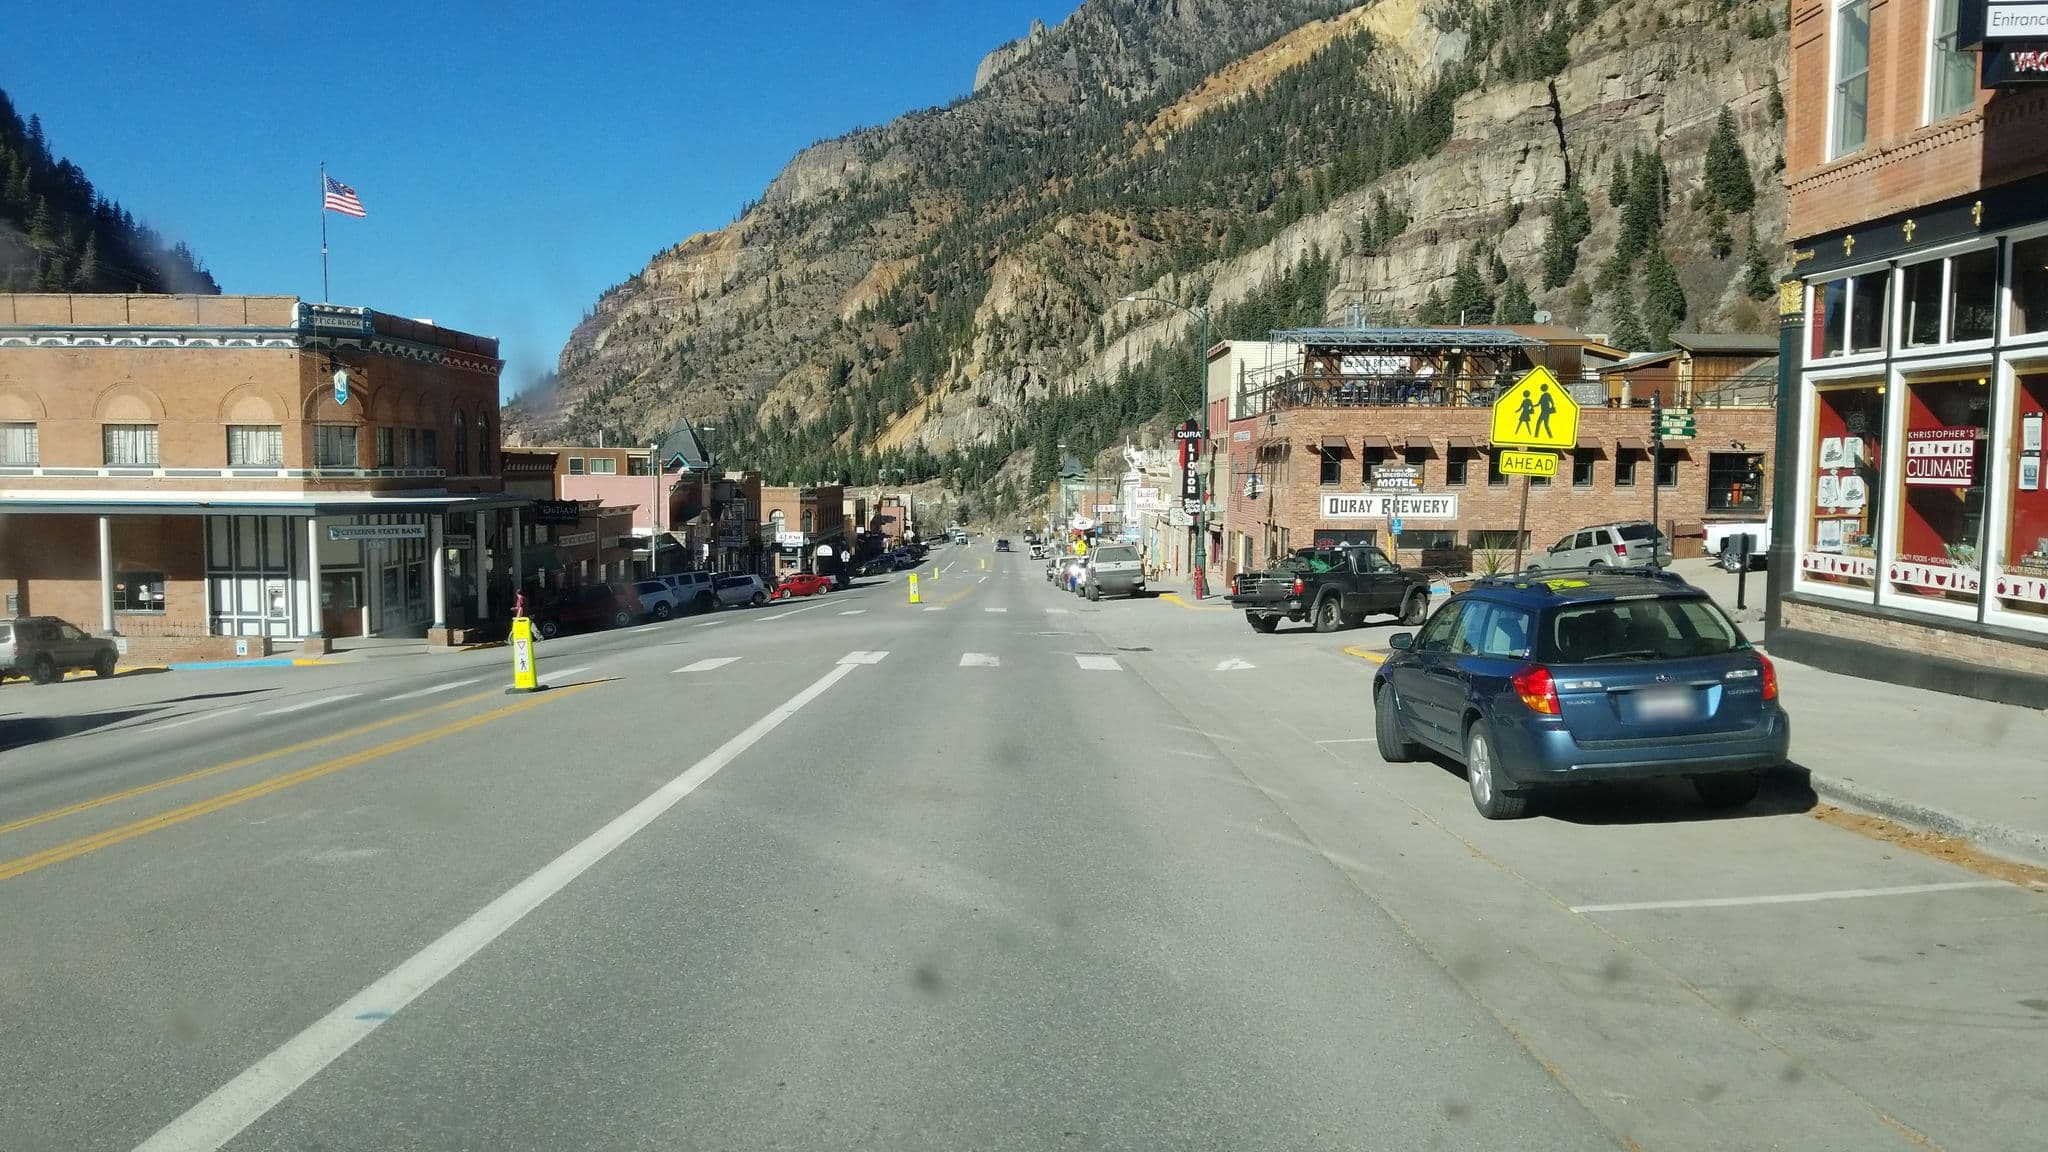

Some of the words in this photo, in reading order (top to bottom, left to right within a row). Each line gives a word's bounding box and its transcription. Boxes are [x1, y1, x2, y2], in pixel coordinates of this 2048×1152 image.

[1992, 11, 2048, 26] Entranc
[338, 319, 361, 327] BLOCK
[1908, 430, 1974, 439] KHRISTOPHER'S
[1187, 443, 1196, 494] LIQUOR
[1503, 456, 1554, 471] AHEAD
[1906, 459, 1973, 477] CULINAIRE
[1377, 478, 1417, 487] MOTEL
[1329, 498, 1372, 514] OURAY
[1381, 498, 1448, 515] BREWERY
[341, 528, 376, 536] CITIZENS
[378, 527, 399, 535] STATE
